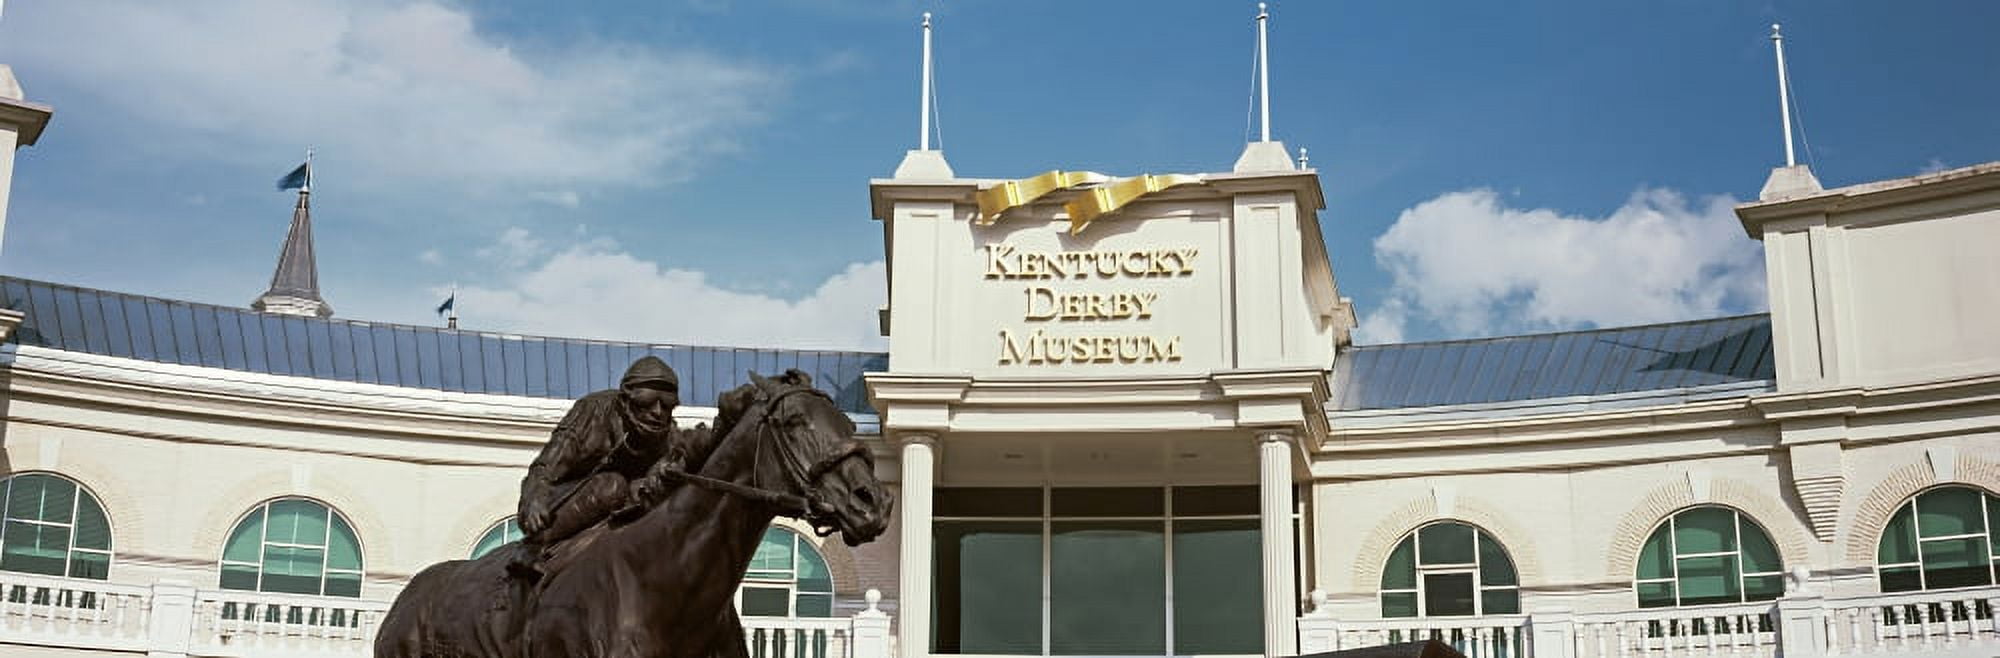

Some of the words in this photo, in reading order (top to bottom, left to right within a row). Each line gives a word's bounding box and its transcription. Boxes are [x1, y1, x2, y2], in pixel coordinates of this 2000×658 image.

[984, 243, 1198, 280] KENTUCKY
[1024, 287, 1157, 322] DERBY
[998, 328, 1182, 365] MUSEUM
